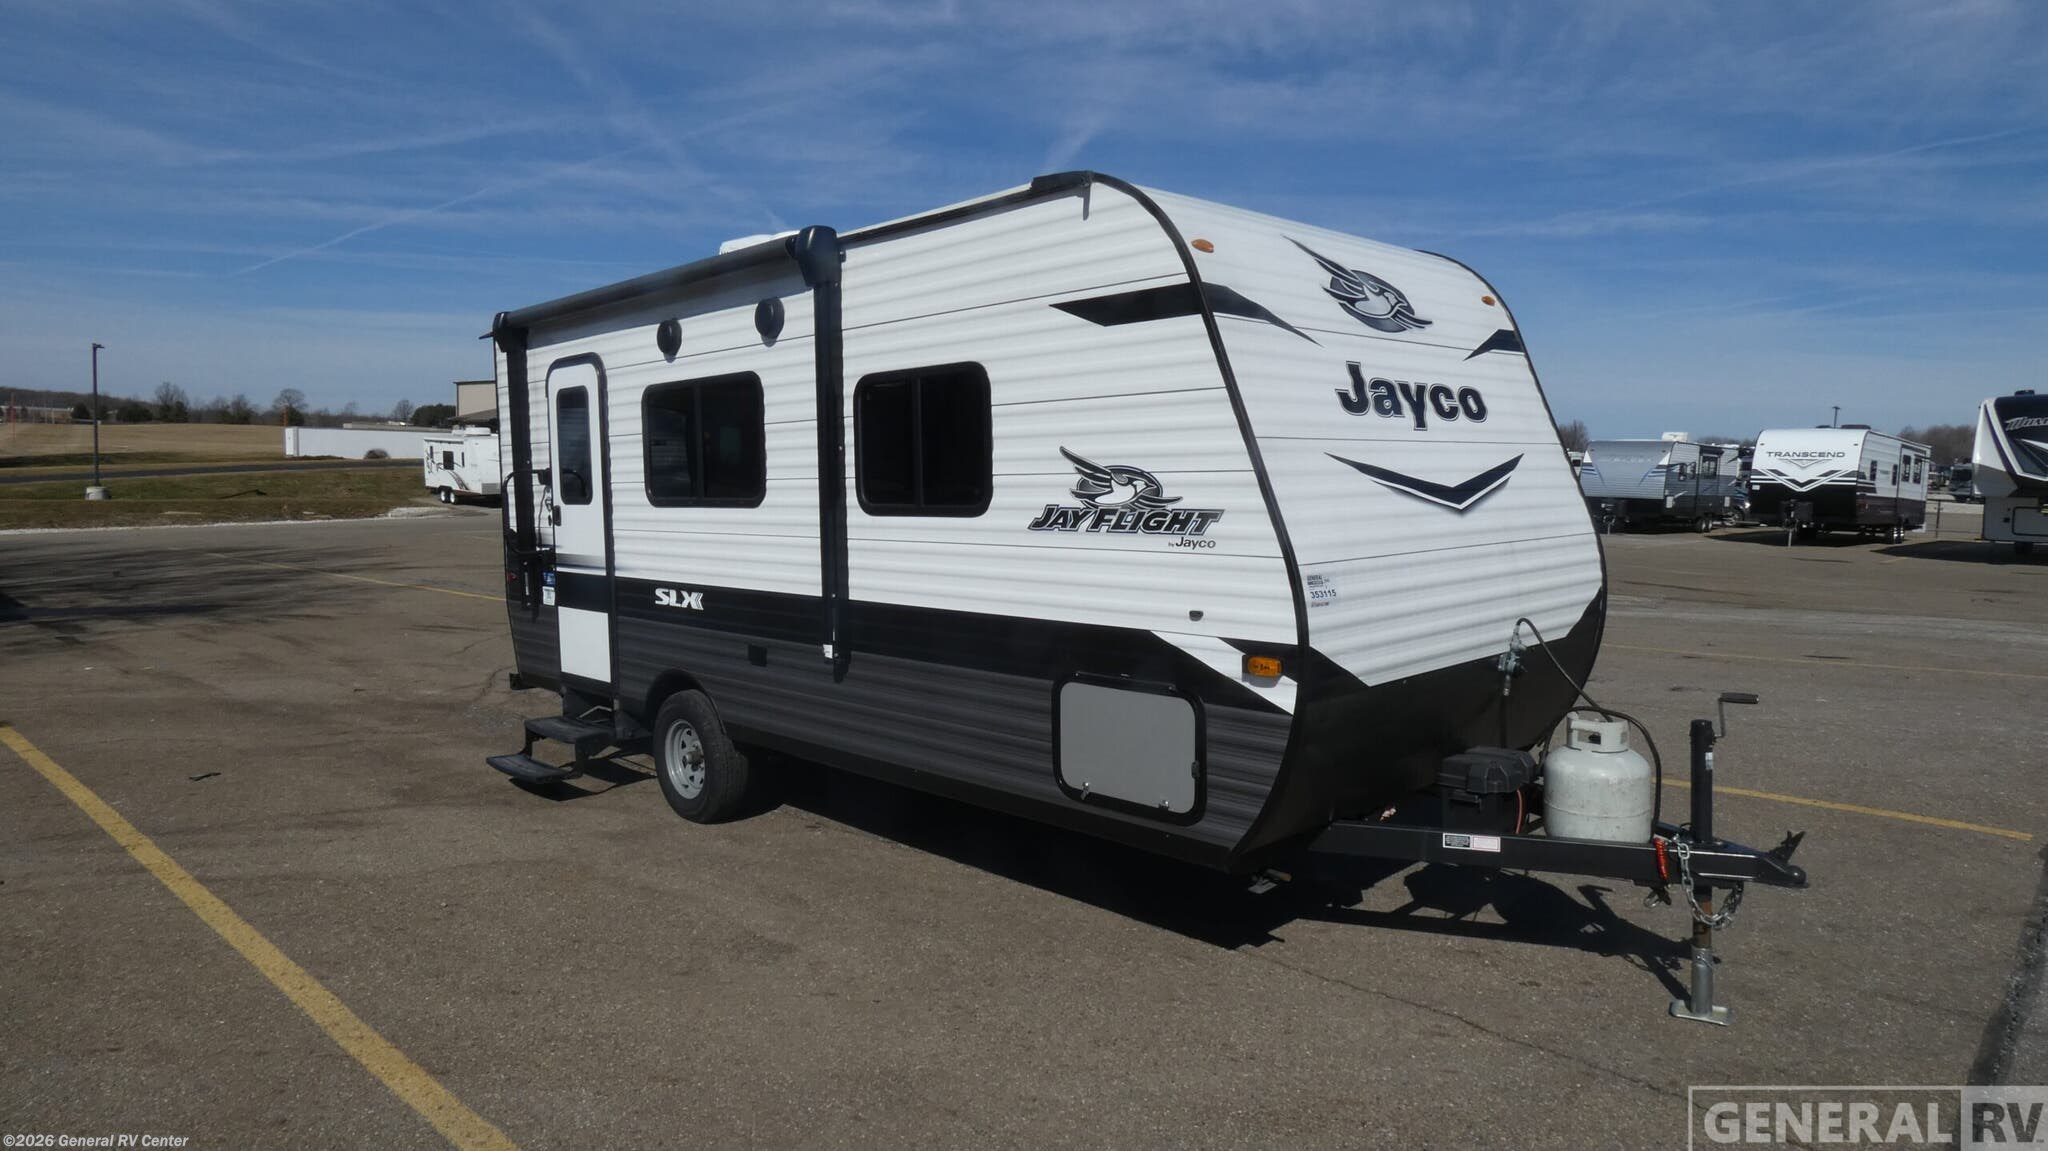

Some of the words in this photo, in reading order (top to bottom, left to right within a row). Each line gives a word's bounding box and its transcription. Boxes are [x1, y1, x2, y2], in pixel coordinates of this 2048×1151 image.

[1335, 360, 1488, 431] Jayco
[1027, 504, 1094, 532] JAY
[1086, 506, 1225, 536] FLIGHT
[1175, 536, 1216, 550] Jayco
[655, 587, 704, 611] SLX
[1310, 589, 1337, 599] 353115
